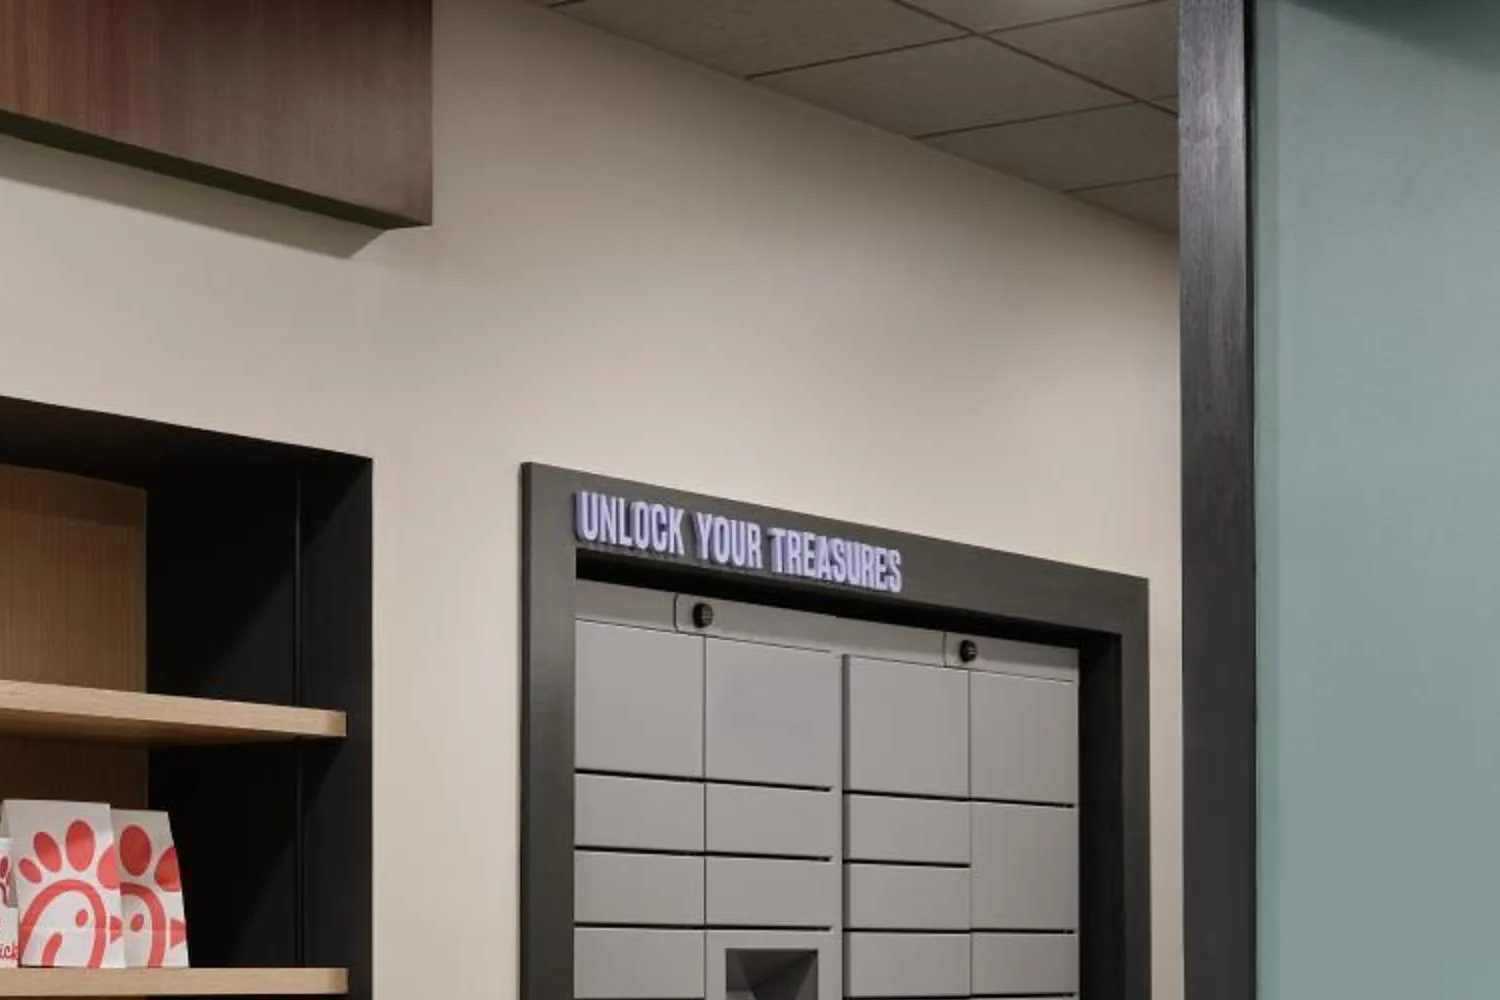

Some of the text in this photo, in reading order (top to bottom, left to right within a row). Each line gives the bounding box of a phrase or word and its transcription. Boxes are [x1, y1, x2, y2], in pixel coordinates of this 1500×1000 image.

[575, 490, 902, 593] UNLOCK YOUR TREASURES
